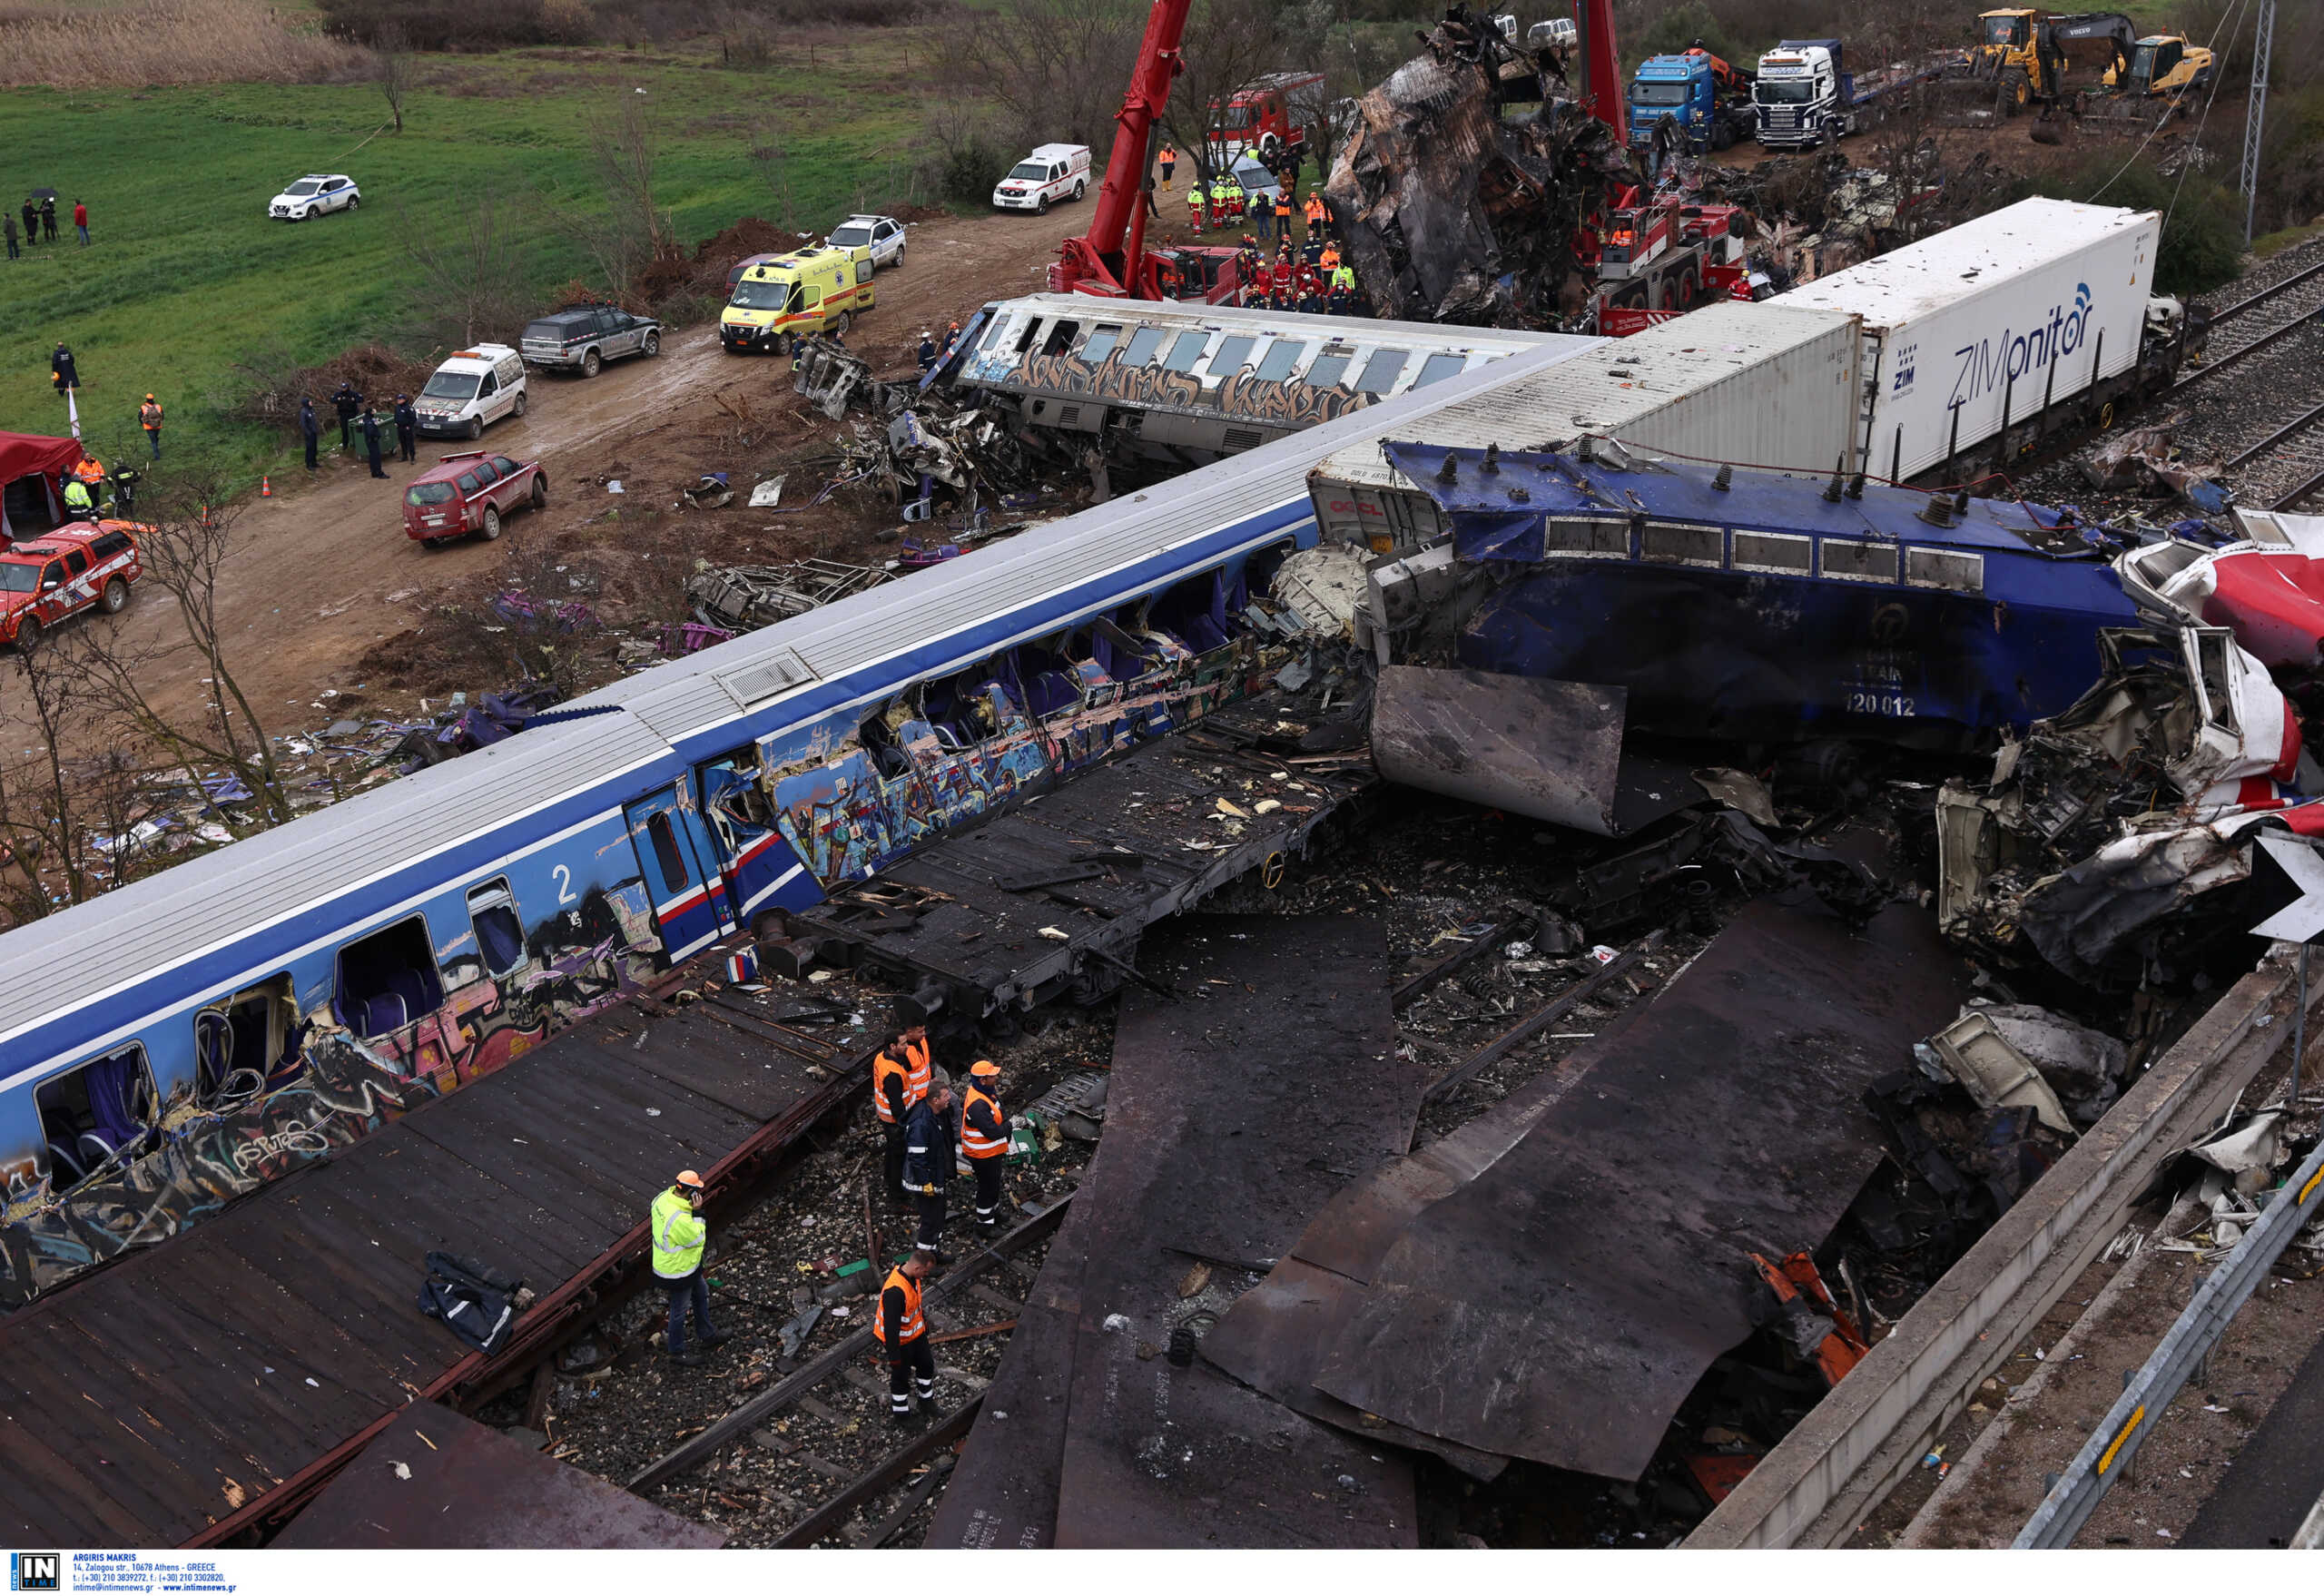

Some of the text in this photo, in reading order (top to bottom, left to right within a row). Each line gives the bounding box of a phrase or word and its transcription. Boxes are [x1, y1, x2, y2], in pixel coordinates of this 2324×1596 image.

[2070, 27, 2091, 36] VOLVO
[1947, 305, 2093, 410] ZIMonitor
[1894, 366, 1915, 391] ZIM
[1882, 695, 1915, 716] 012
[552, 864, 577, 906] 2
